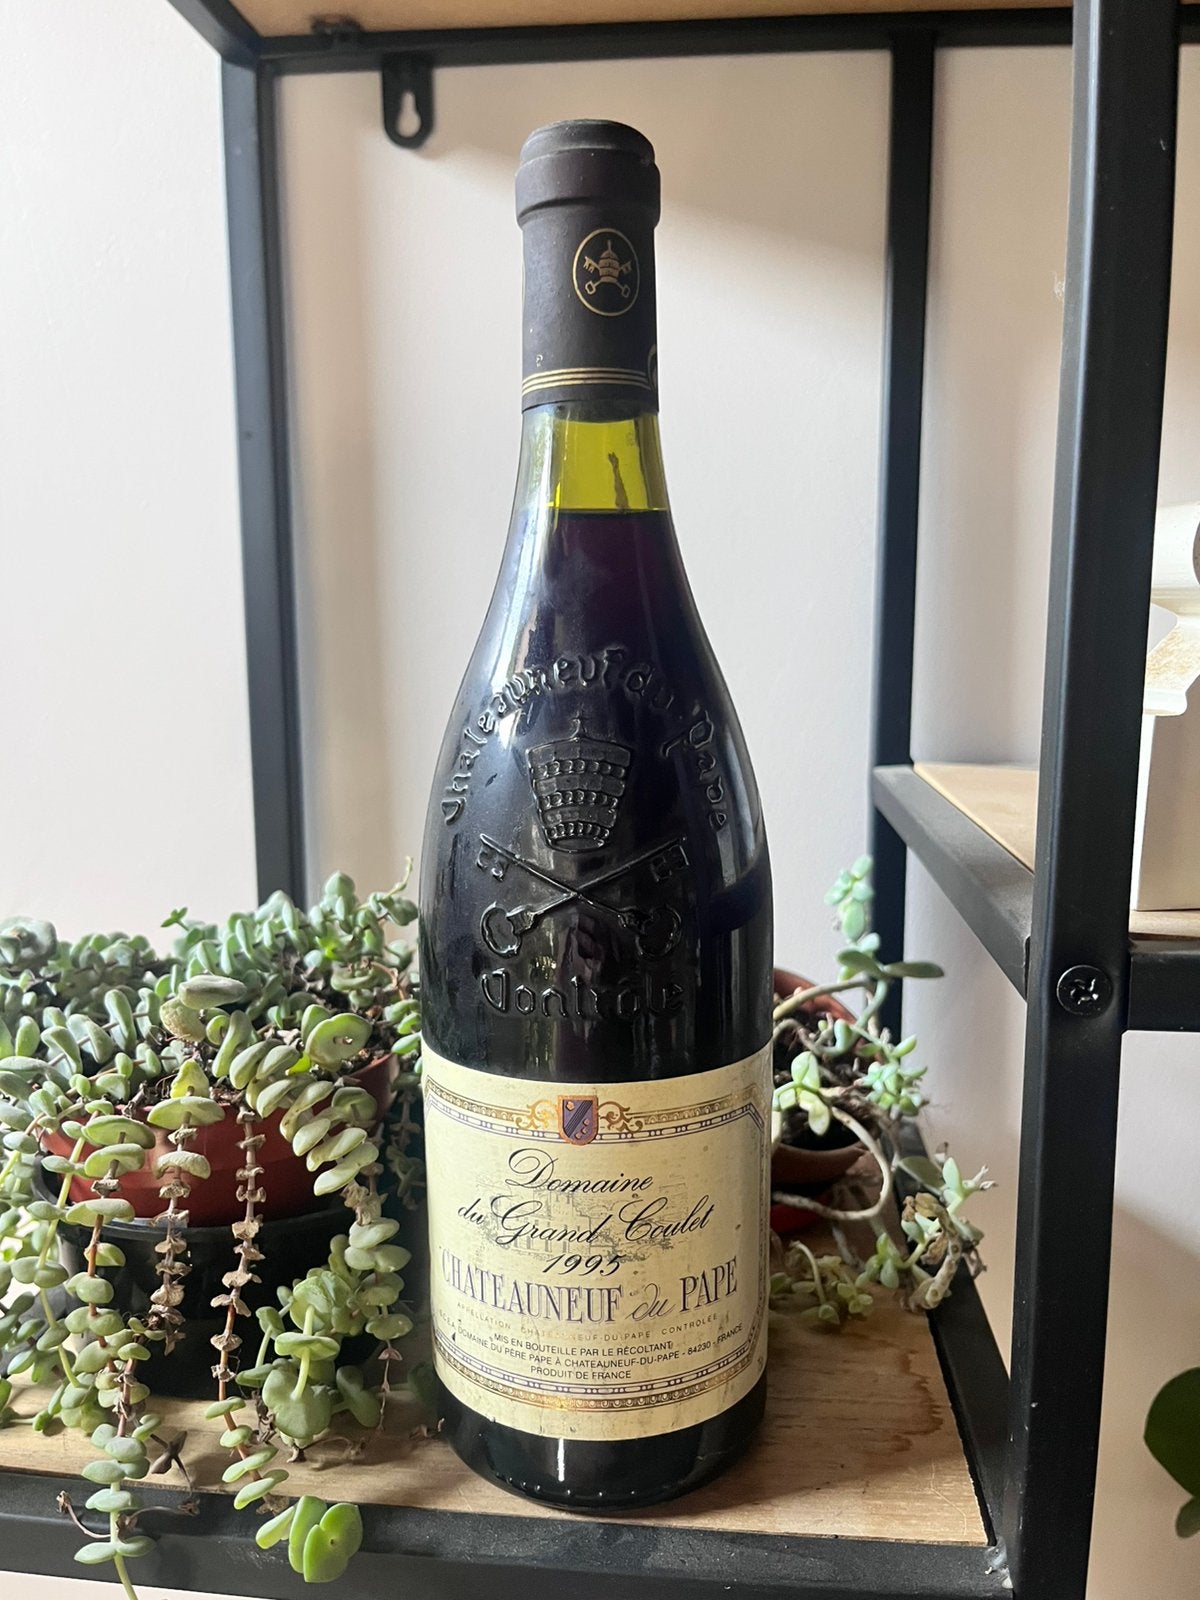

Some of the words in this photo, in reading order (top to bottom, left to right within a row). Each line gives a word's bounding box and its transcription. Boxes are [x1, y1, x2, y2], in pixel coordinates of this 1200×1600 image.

[505, 1148, 653, 1194] Domaine
[457, 1198, 483, 1226] du
[490, 1195, 611, 1246] Grand
[618, 1194, 714, 1242] Coulet
[442, 1248, 622, 1324] CHATEAUNEUF
[625, 1283, 676, 1322] du
[679, 1256, 737, 1313] PAPE
[541, 1253, 629, 1278] 1995
[457, 1302, 511, 1331] APPELLATION
[521, 1325, 651, 1342] CHATENEUF-DU-PAPE
[457, 1327, 489, 1349] DOMAINE
[490, 1340, 503, 1354] DU
[529, 1354, 552, 1365] PAPE
[564, 1350, 680, 1369] CHATEAUNEUF-DU-PAPE
[687, 1341, 711, 1356] 84230
[717, 1322, 743, 1345] FRANCE
[493, 1332, 510, 1345] MIS
[511, 1338, 524, 1349] EN
[526, 1340, 577, 1356] BOUTEILLE
[580, 1348, 599, 1357] PAR
[602, 1348, 614, 1357] LE
[617, 1340, 672, 1356] RÉCOLTANT
[530, 1365, 575, 1380] PRODUIT
[576, 1370, 588, 1381] DE
[591, 1370, 632, 1381] FRANCE
